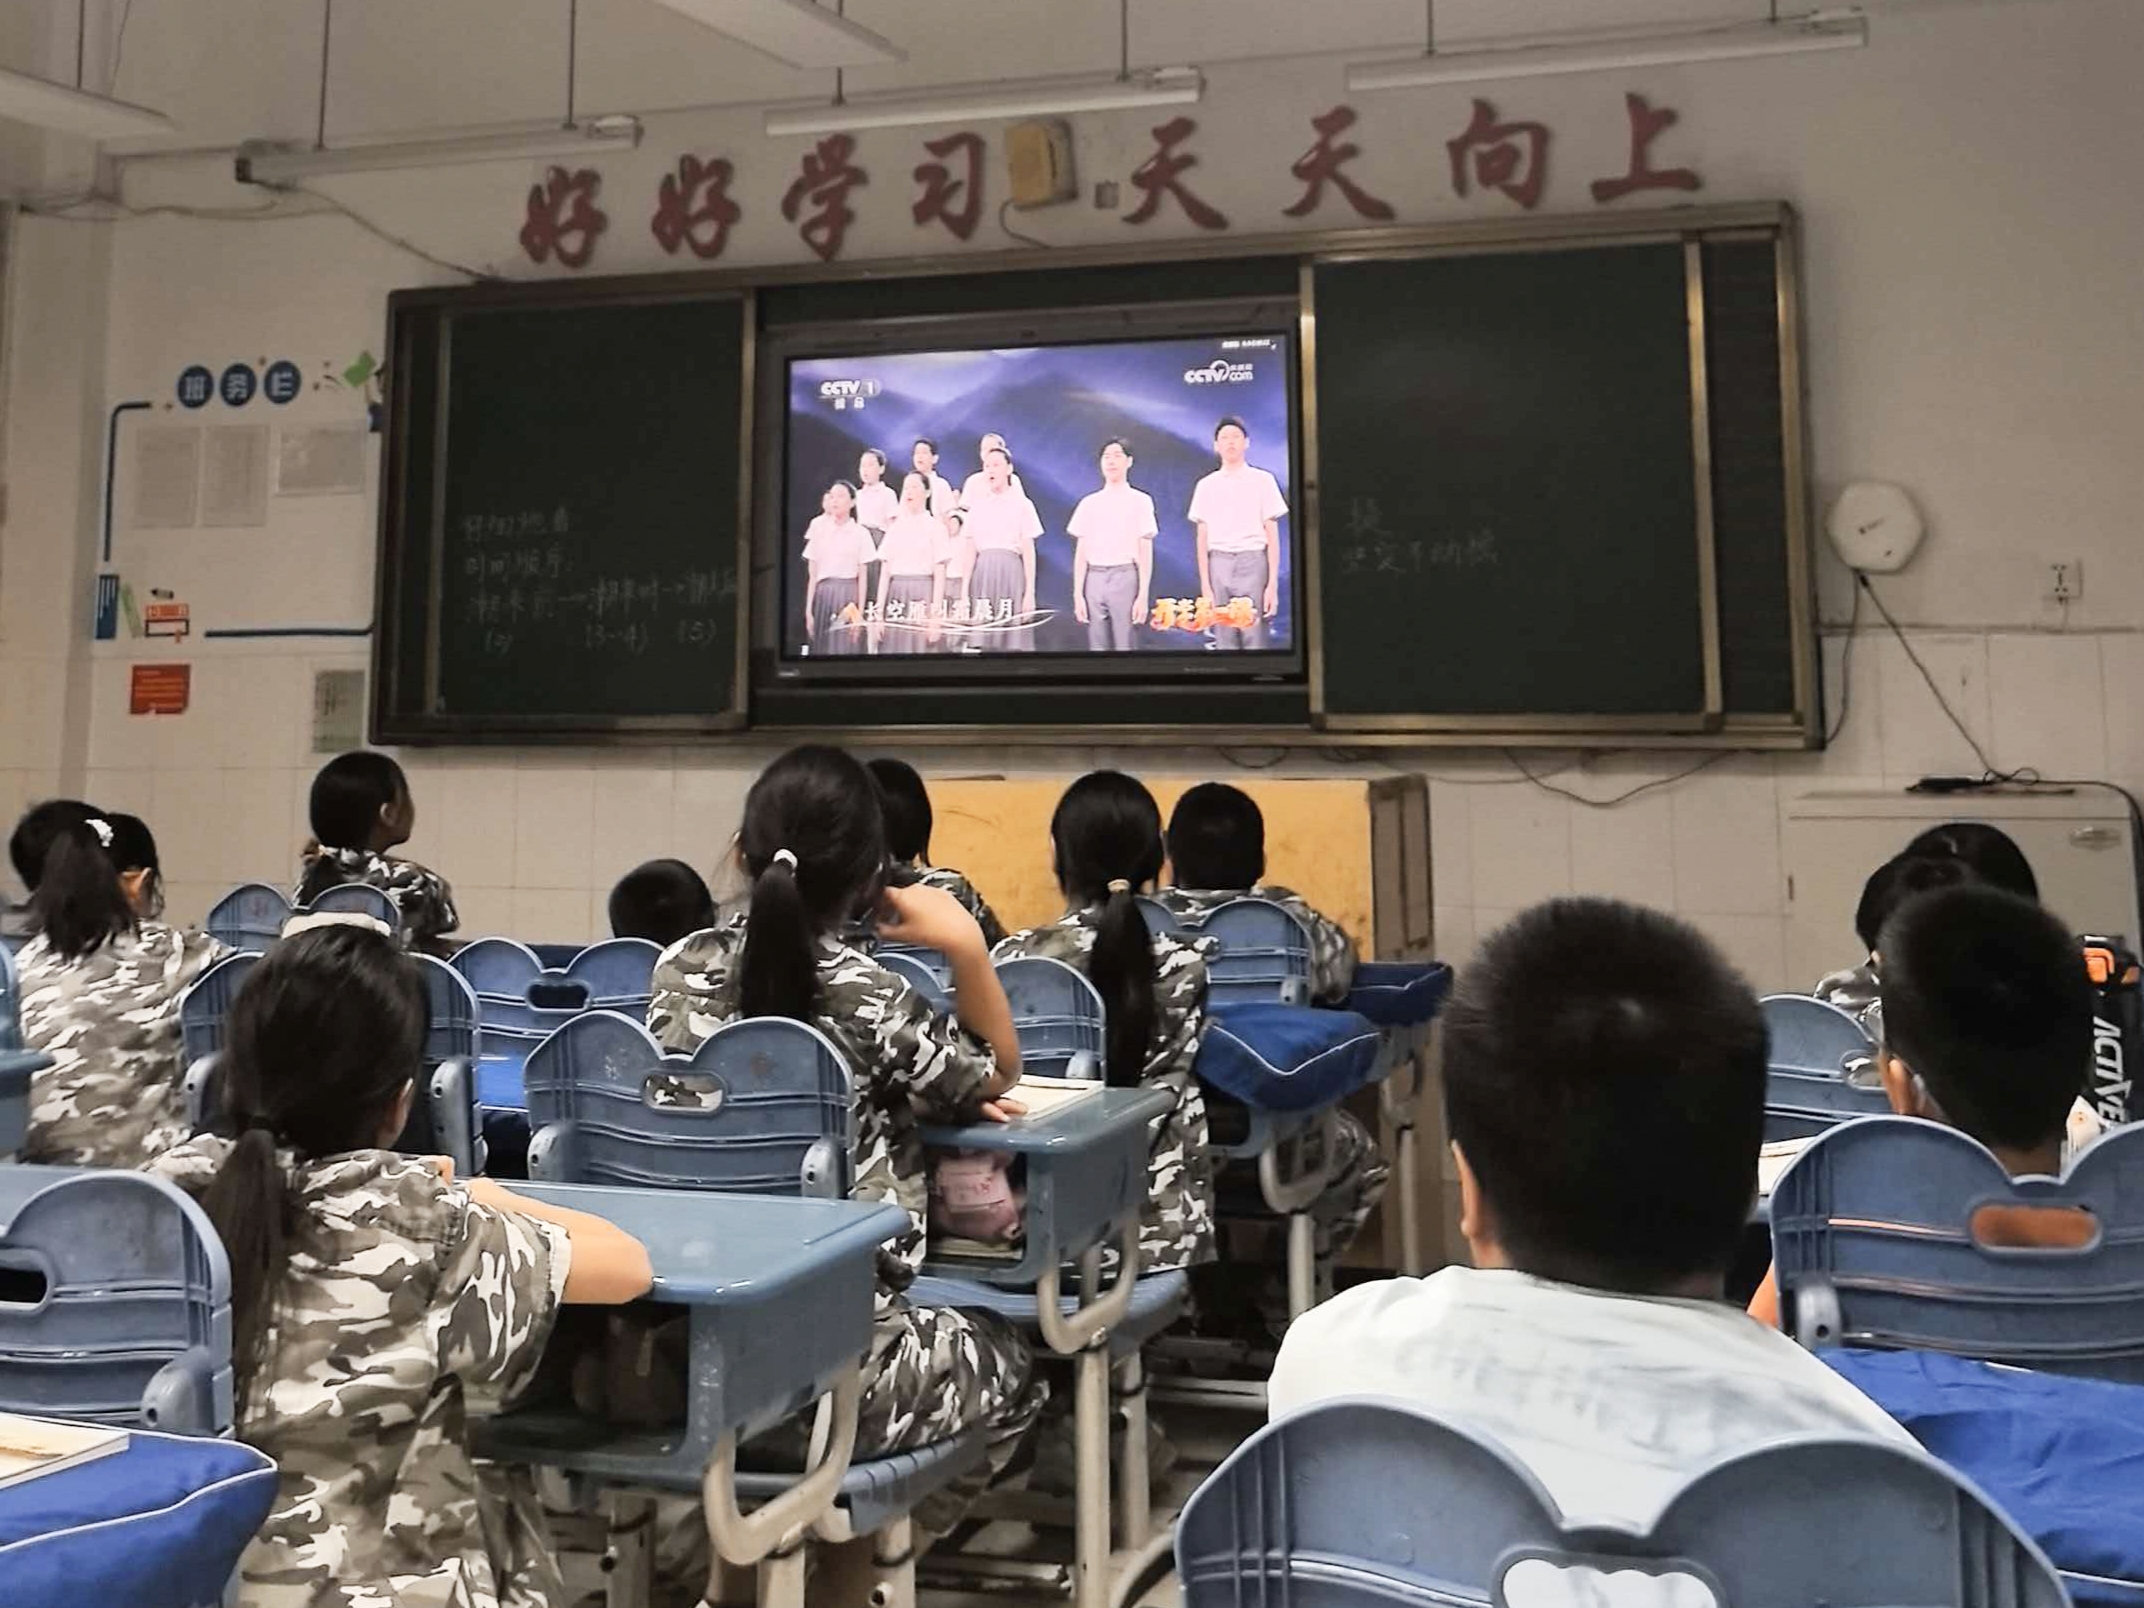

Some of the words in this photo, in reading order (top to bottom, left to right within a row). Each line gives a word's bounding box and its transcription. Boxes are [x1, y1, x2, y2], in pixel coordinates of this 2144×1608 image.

[519, 132, 985, 269] 好好学习
[1121, 93, 1702, 231] 天天向上
[1184, 364, 1228, 384] CCTV
[1229, 370, 1254, 382] com
[821, 380, 861, 396] CCTV
[864, 598, 1014, 622] 长空雁叫霜晨月
[2092, 1015, 2133, 1123] ACTIVE
